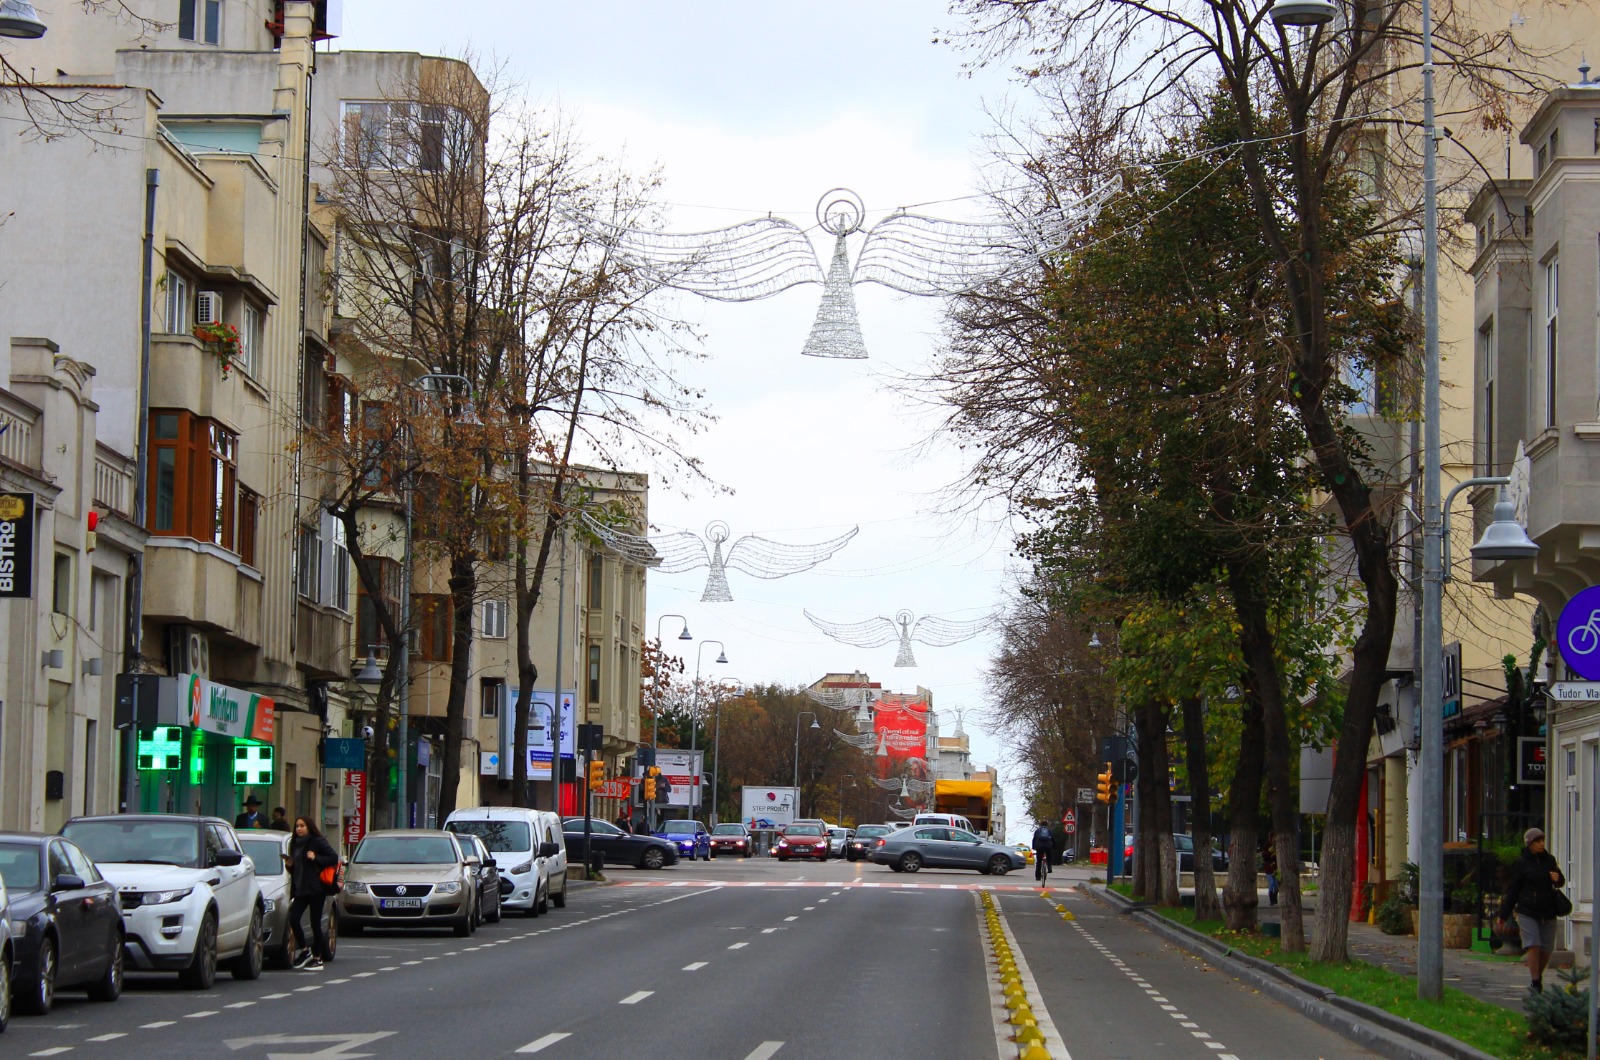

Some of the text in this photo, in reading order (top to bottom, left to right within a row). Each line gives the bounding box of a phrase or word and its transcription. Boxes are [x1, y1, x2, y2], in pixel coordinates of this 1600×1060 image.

[0, 521, 16, 592] BISTRO
[1558, 688, 1600, 698] Tudor Vla
